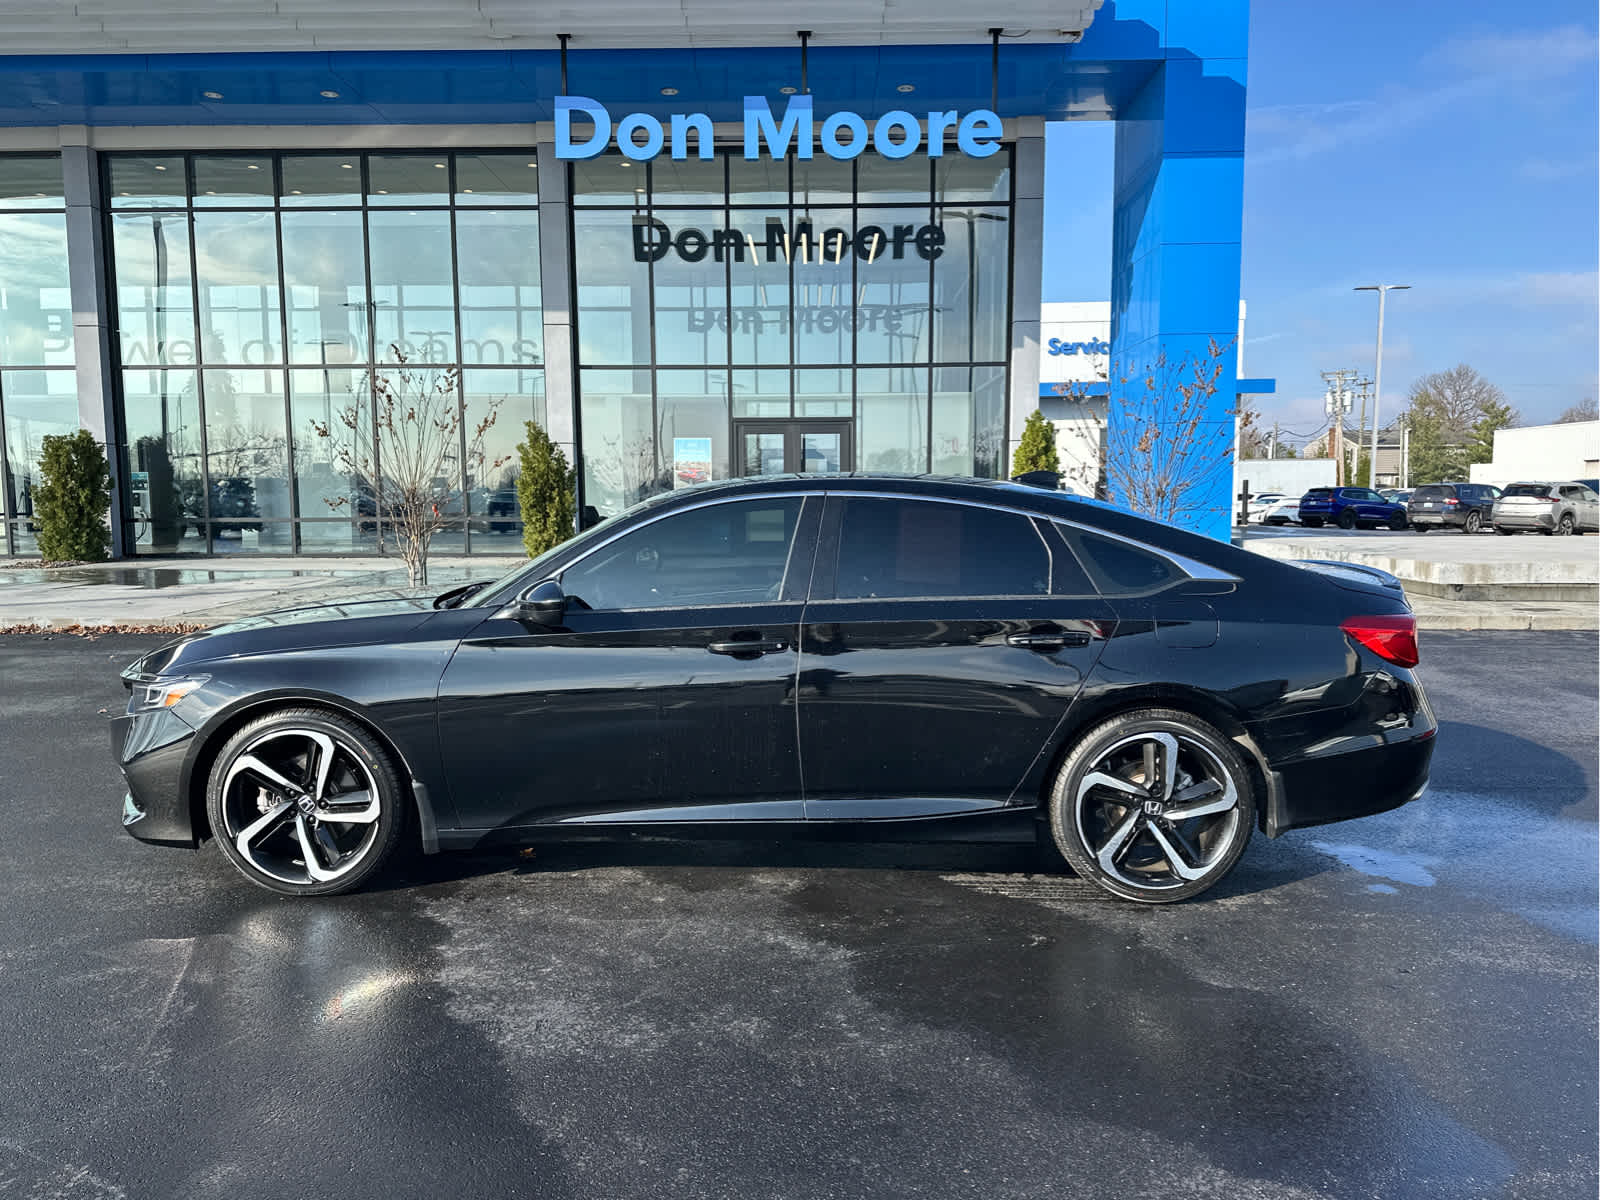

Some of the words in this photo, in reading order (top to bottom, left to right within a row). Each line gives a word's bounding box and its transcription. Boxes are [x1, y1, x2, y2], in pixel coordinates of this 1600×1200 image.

[554, 95, 715, 162] Don
[743, 95, 1004, 161] Moore
[632, 214, 745, 263] Don
[765, 216, 946, 263] Moore
[1048, 337, 1111, 356] Servic
